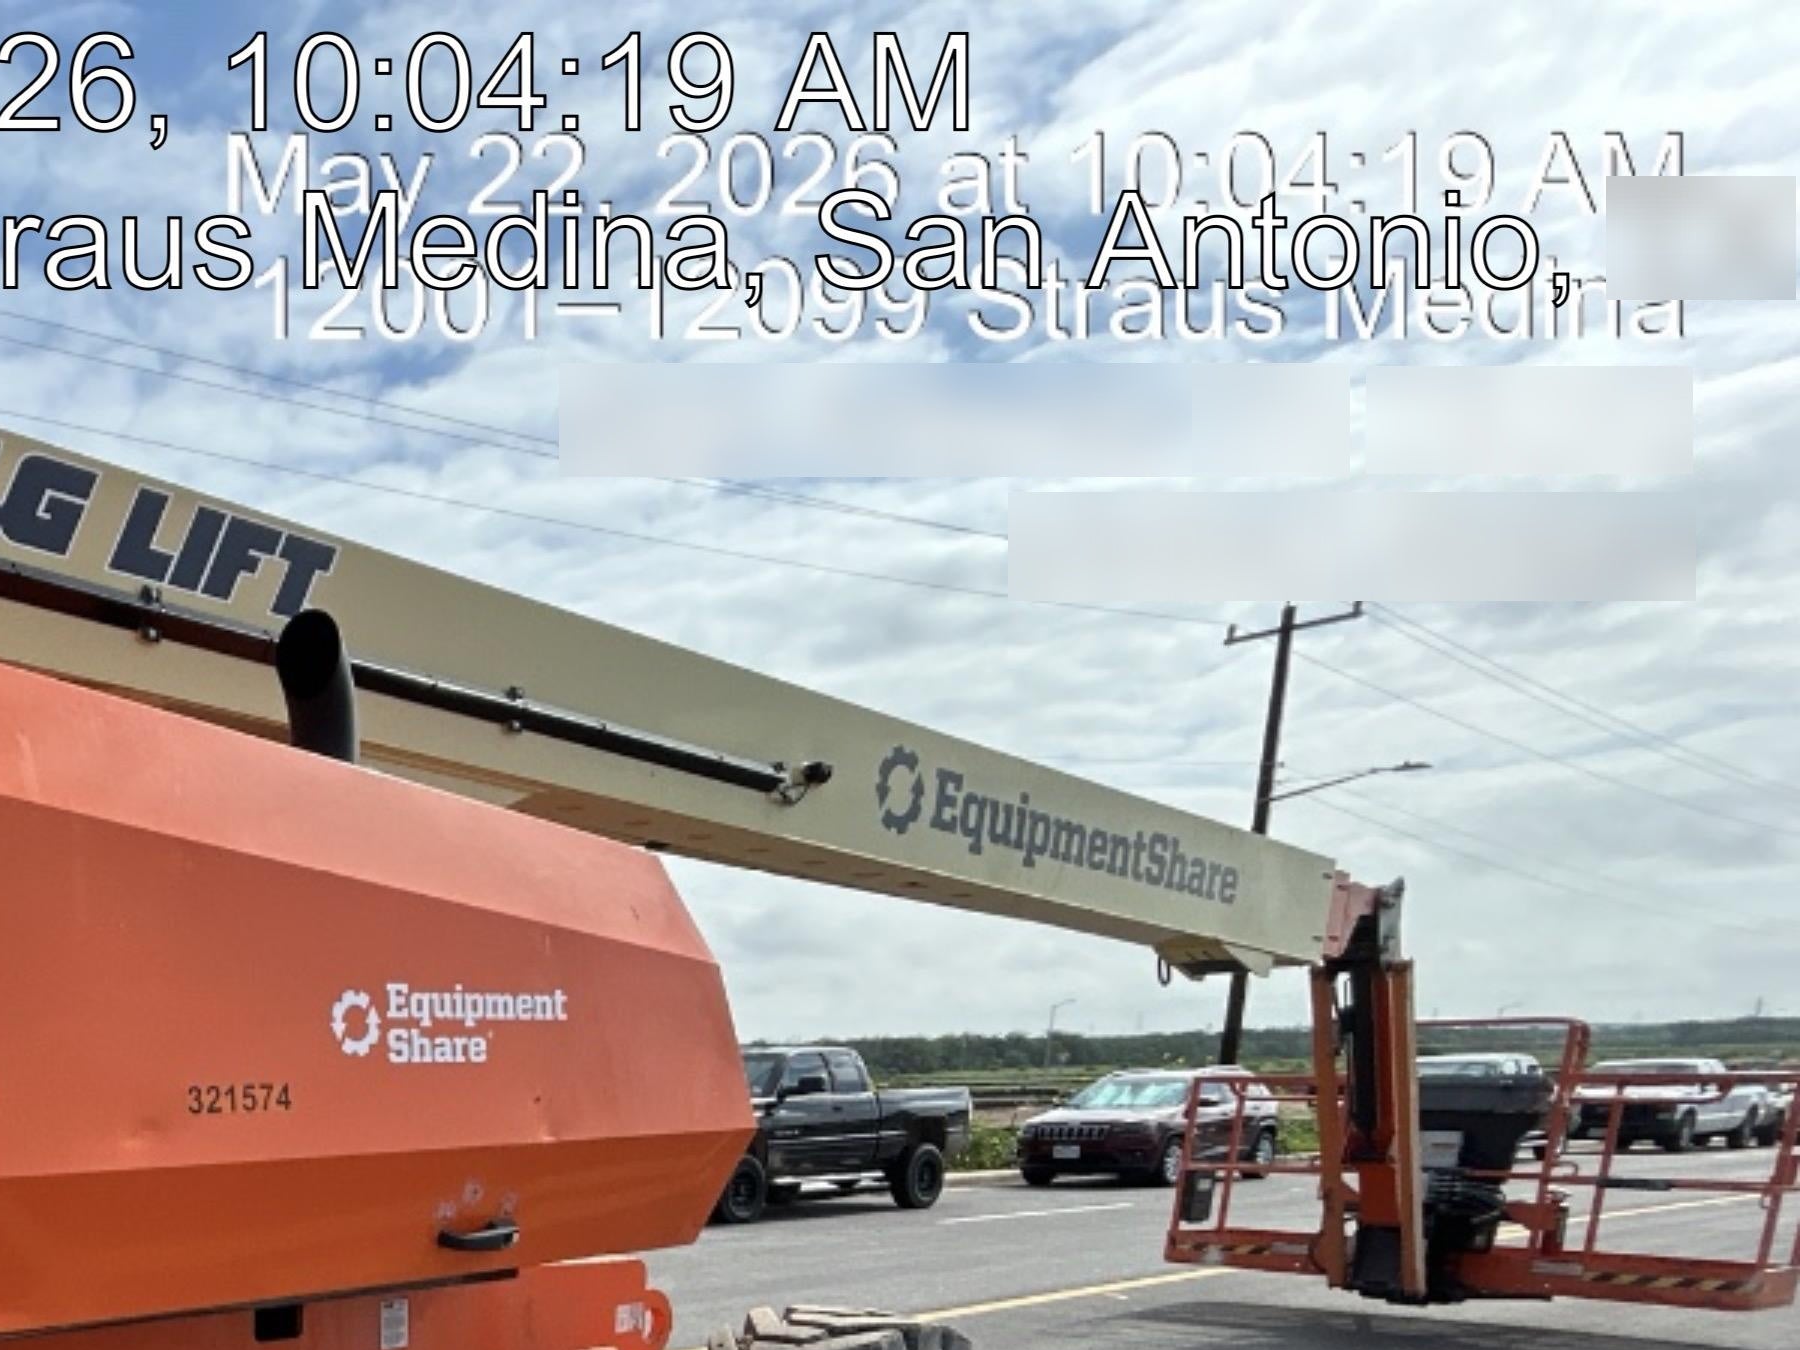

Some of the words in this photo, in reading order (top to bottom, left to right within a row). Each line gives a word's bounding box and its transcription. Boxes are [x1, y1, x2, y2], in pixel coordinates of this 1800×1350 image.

[105, 484, 341, 620] LIFT
[929, 766, 1239, 904] EquipmentShare
[386, 983, 568, 1027] Equipment
[386, 1028, 489, 1063] Share
[187, 1082, 292, 1114] 321574
